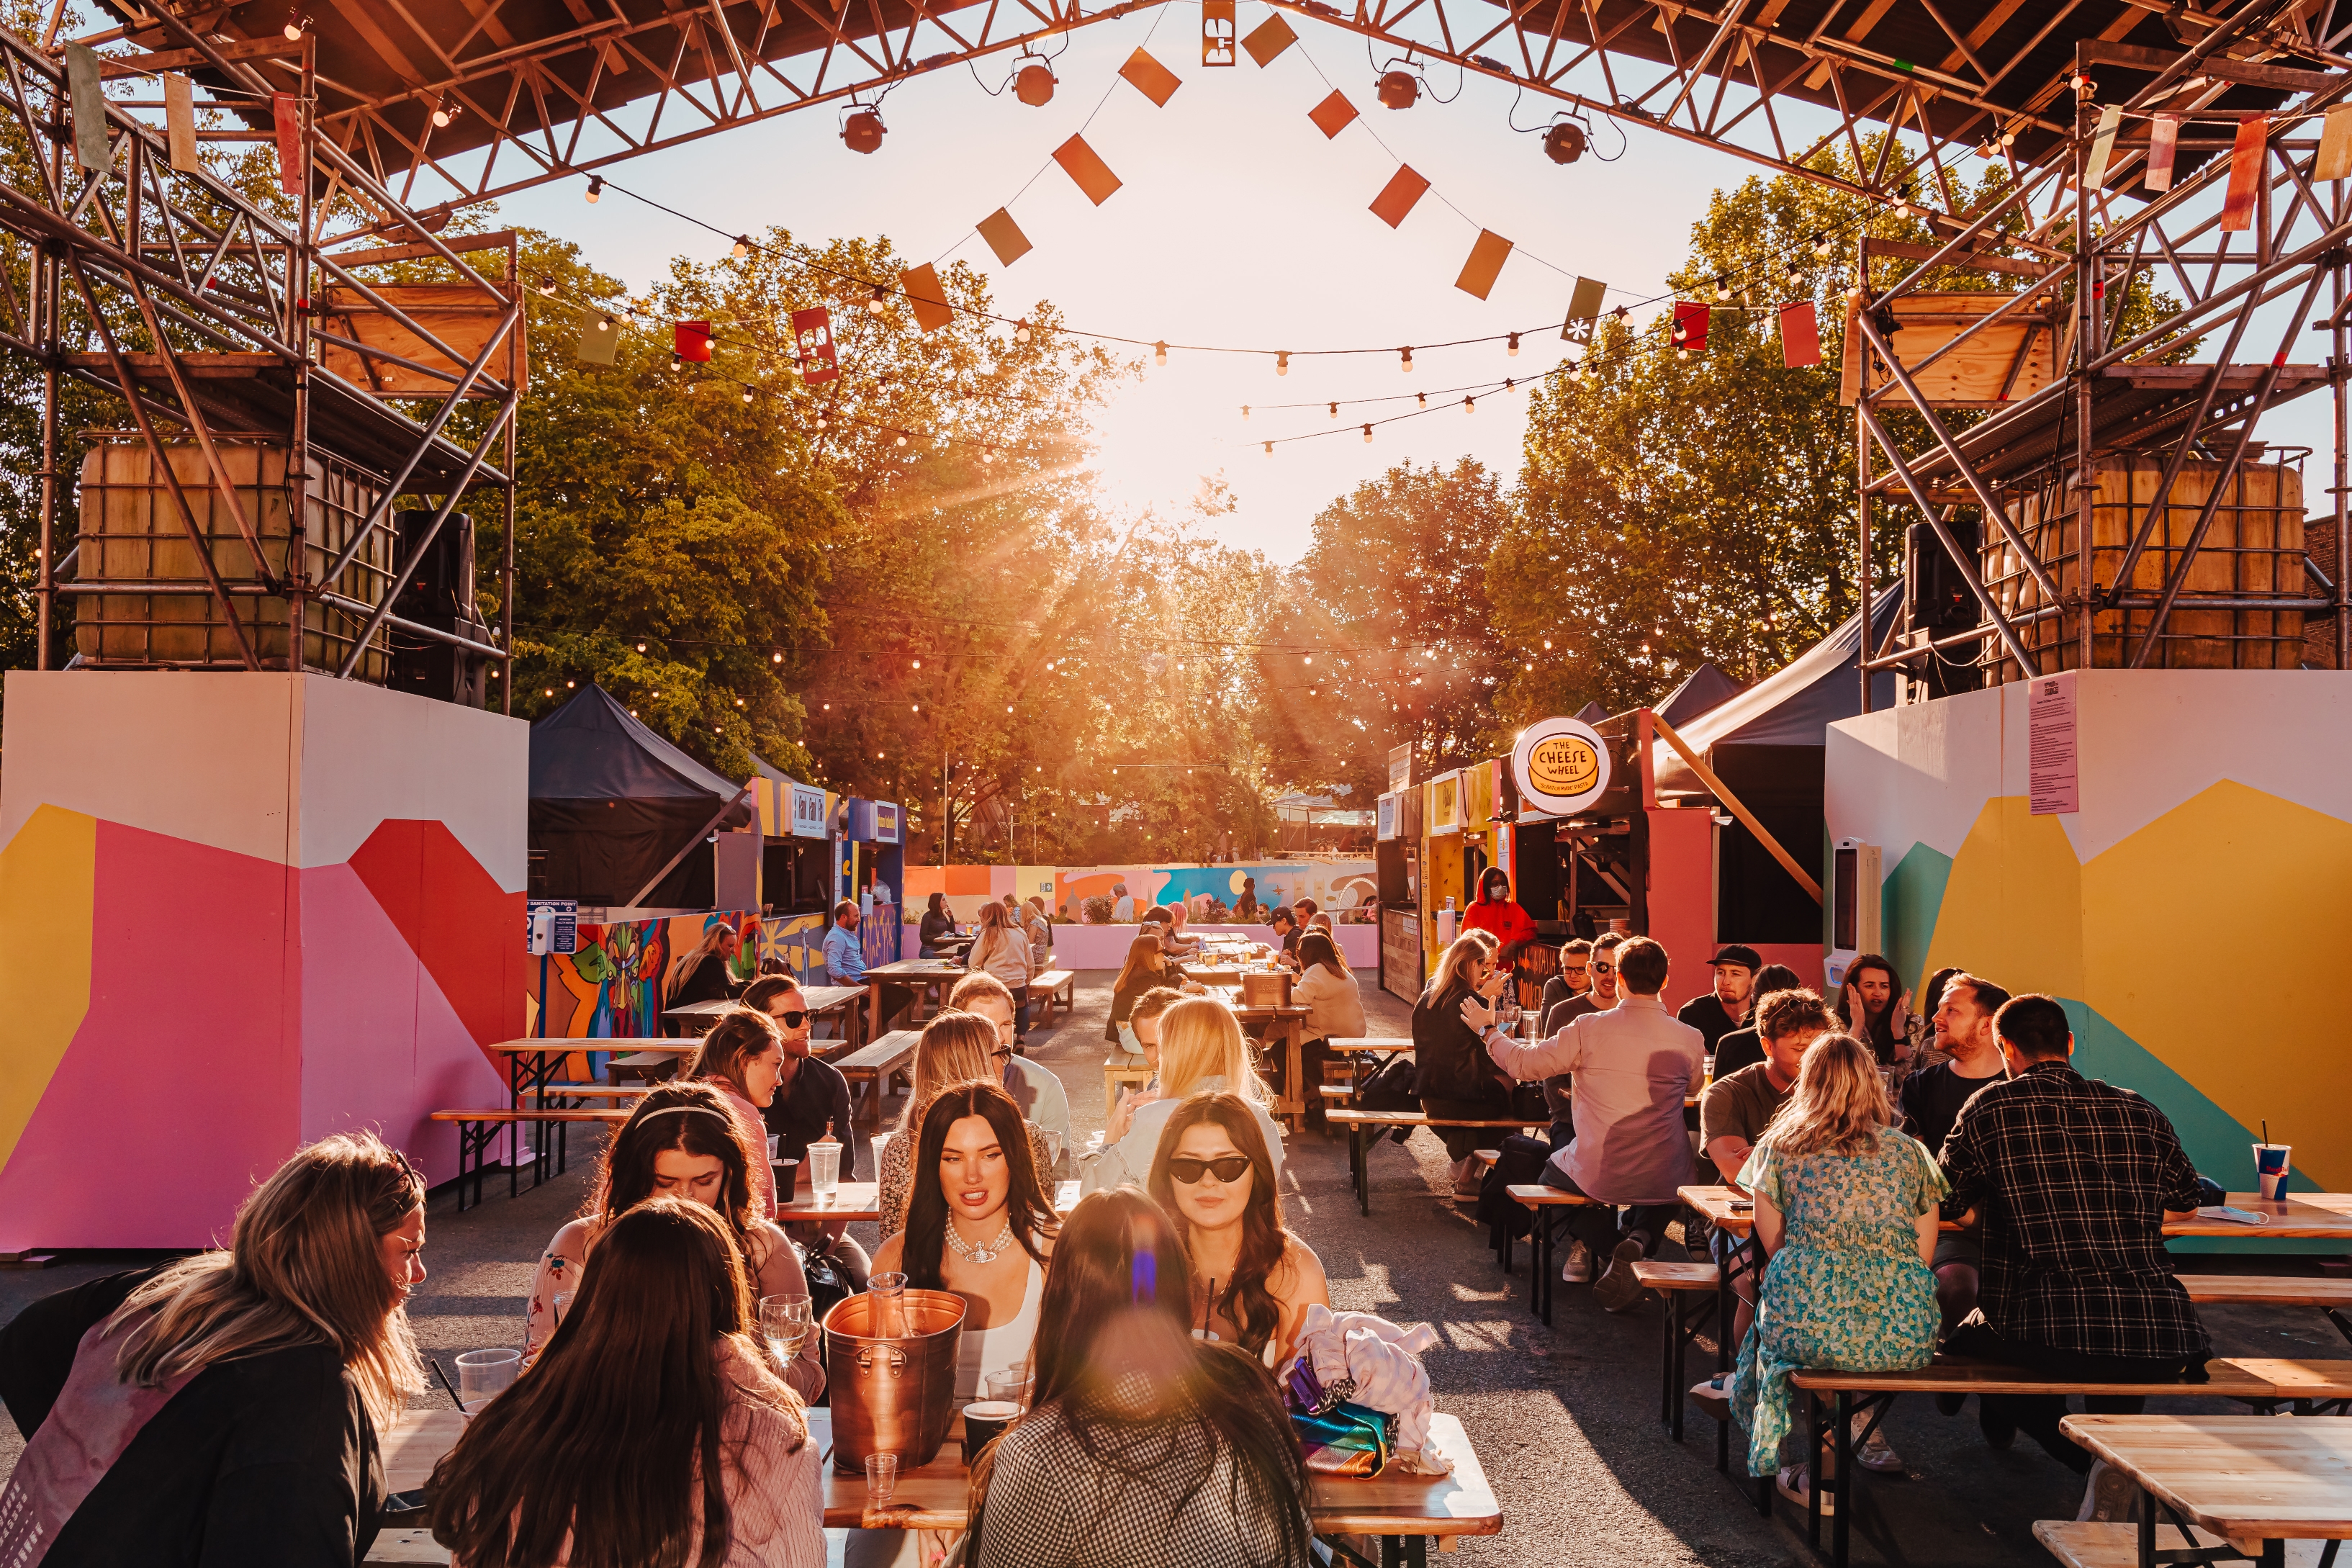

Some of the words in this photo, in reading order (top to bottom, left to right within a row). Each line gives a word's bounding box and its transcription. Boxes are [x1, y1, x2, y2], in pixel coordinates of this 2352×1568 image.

[1539, 750, 1587, 764] CHEESE
[1547, 765, 1580, 775] WHEEL
[1574, 781, 1589, 790] PASTA
